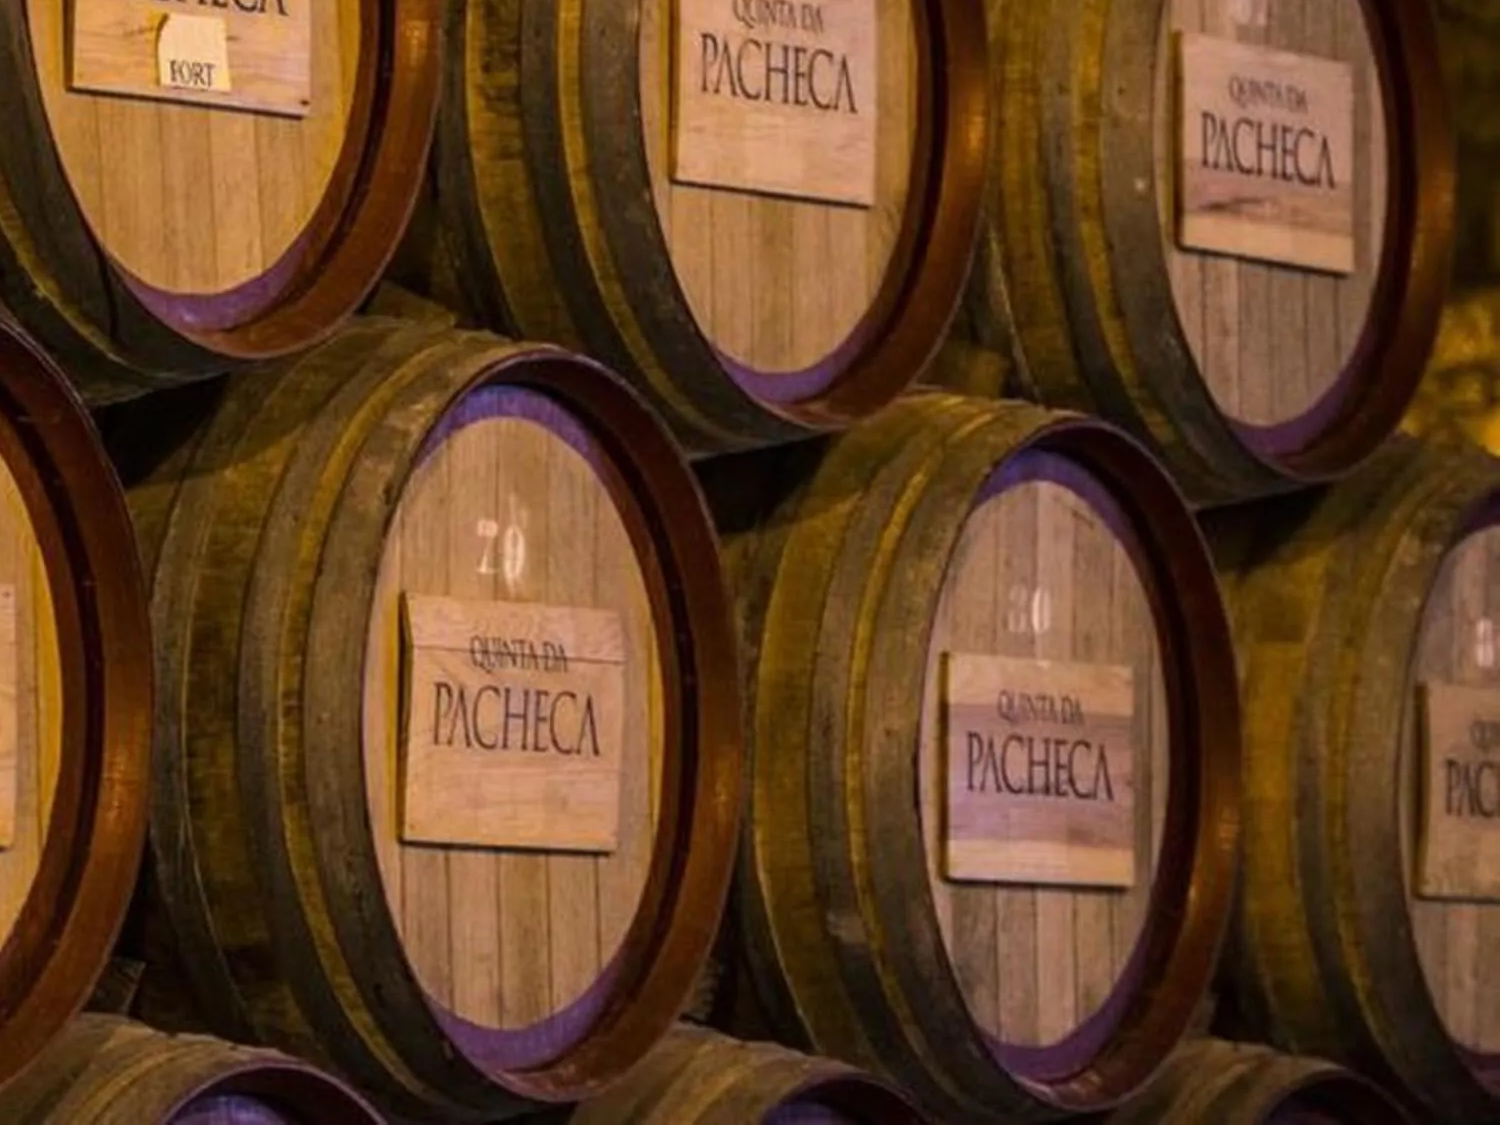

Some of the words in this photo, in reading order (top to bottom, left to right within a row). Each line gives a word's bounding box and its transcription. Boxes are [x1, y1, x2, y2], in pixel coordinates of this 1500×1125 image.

[801, 0, 825, 34] DA
[699, 33, 859, 115] PACHECA
[1201, 112, 1337, 190] PACHECA
[469, 635, 540, 674] QUINTA
[543, 641, 569, 673] DA
[433, 682, 601, 757] PACHECA
[997, 690, 1057, 725] QUINTA
[1061, 696, 1086, 726] DA
[967, 730, 1115, 802] PACHECA
